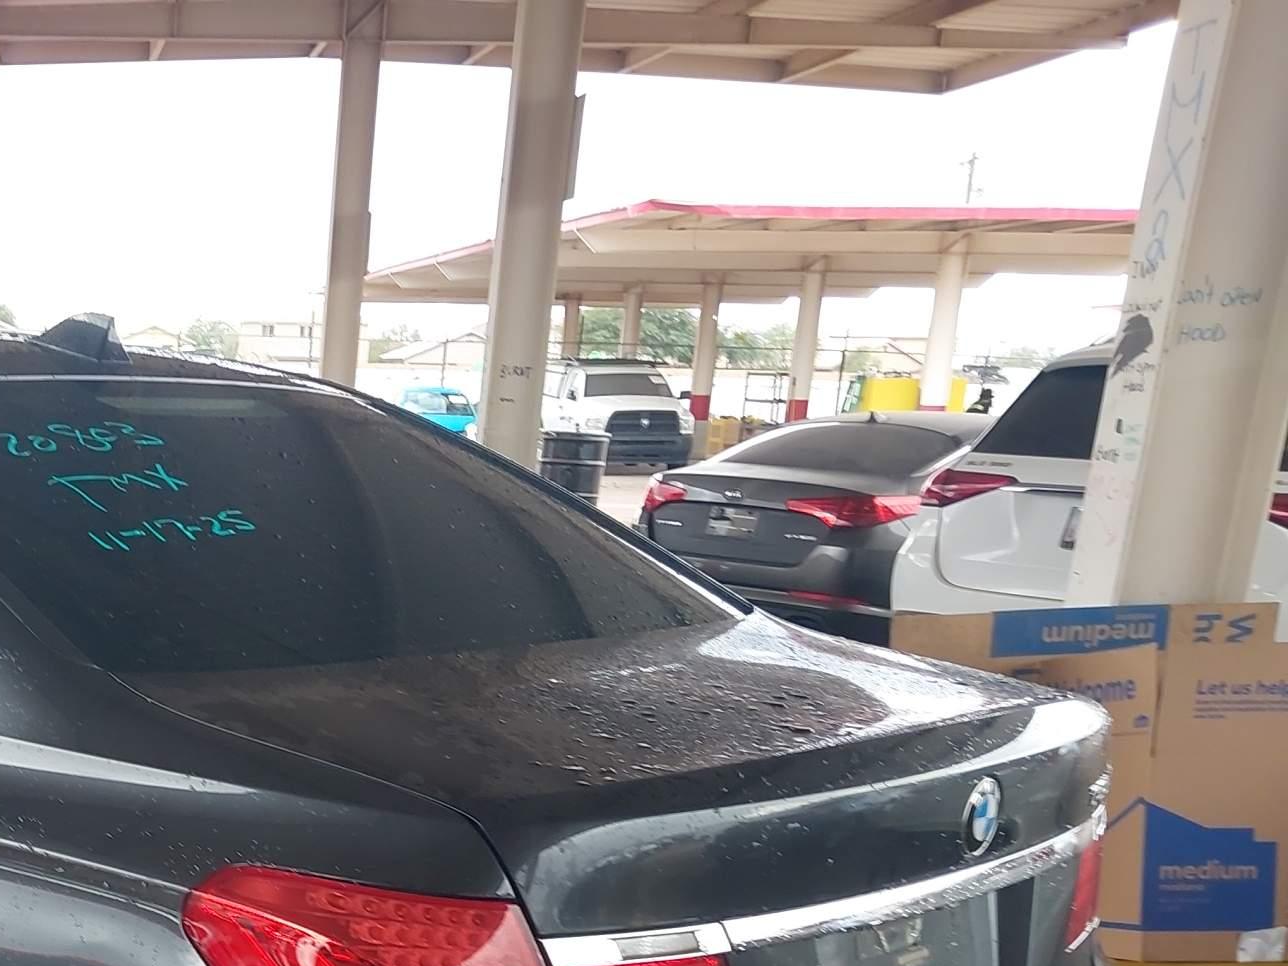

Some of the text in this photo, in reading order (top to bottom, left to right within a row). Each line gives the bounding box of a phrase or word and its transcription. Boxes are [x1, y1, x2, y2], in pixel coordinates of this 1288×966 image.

[87, 510, 256, 551] 11-17-25
[1043, 621, 1155, 648] medium
[1196, 680, 1226, 695] Let
[1230, 683, 1252, 695] us
[1159, 859, 1257, 879] medium
